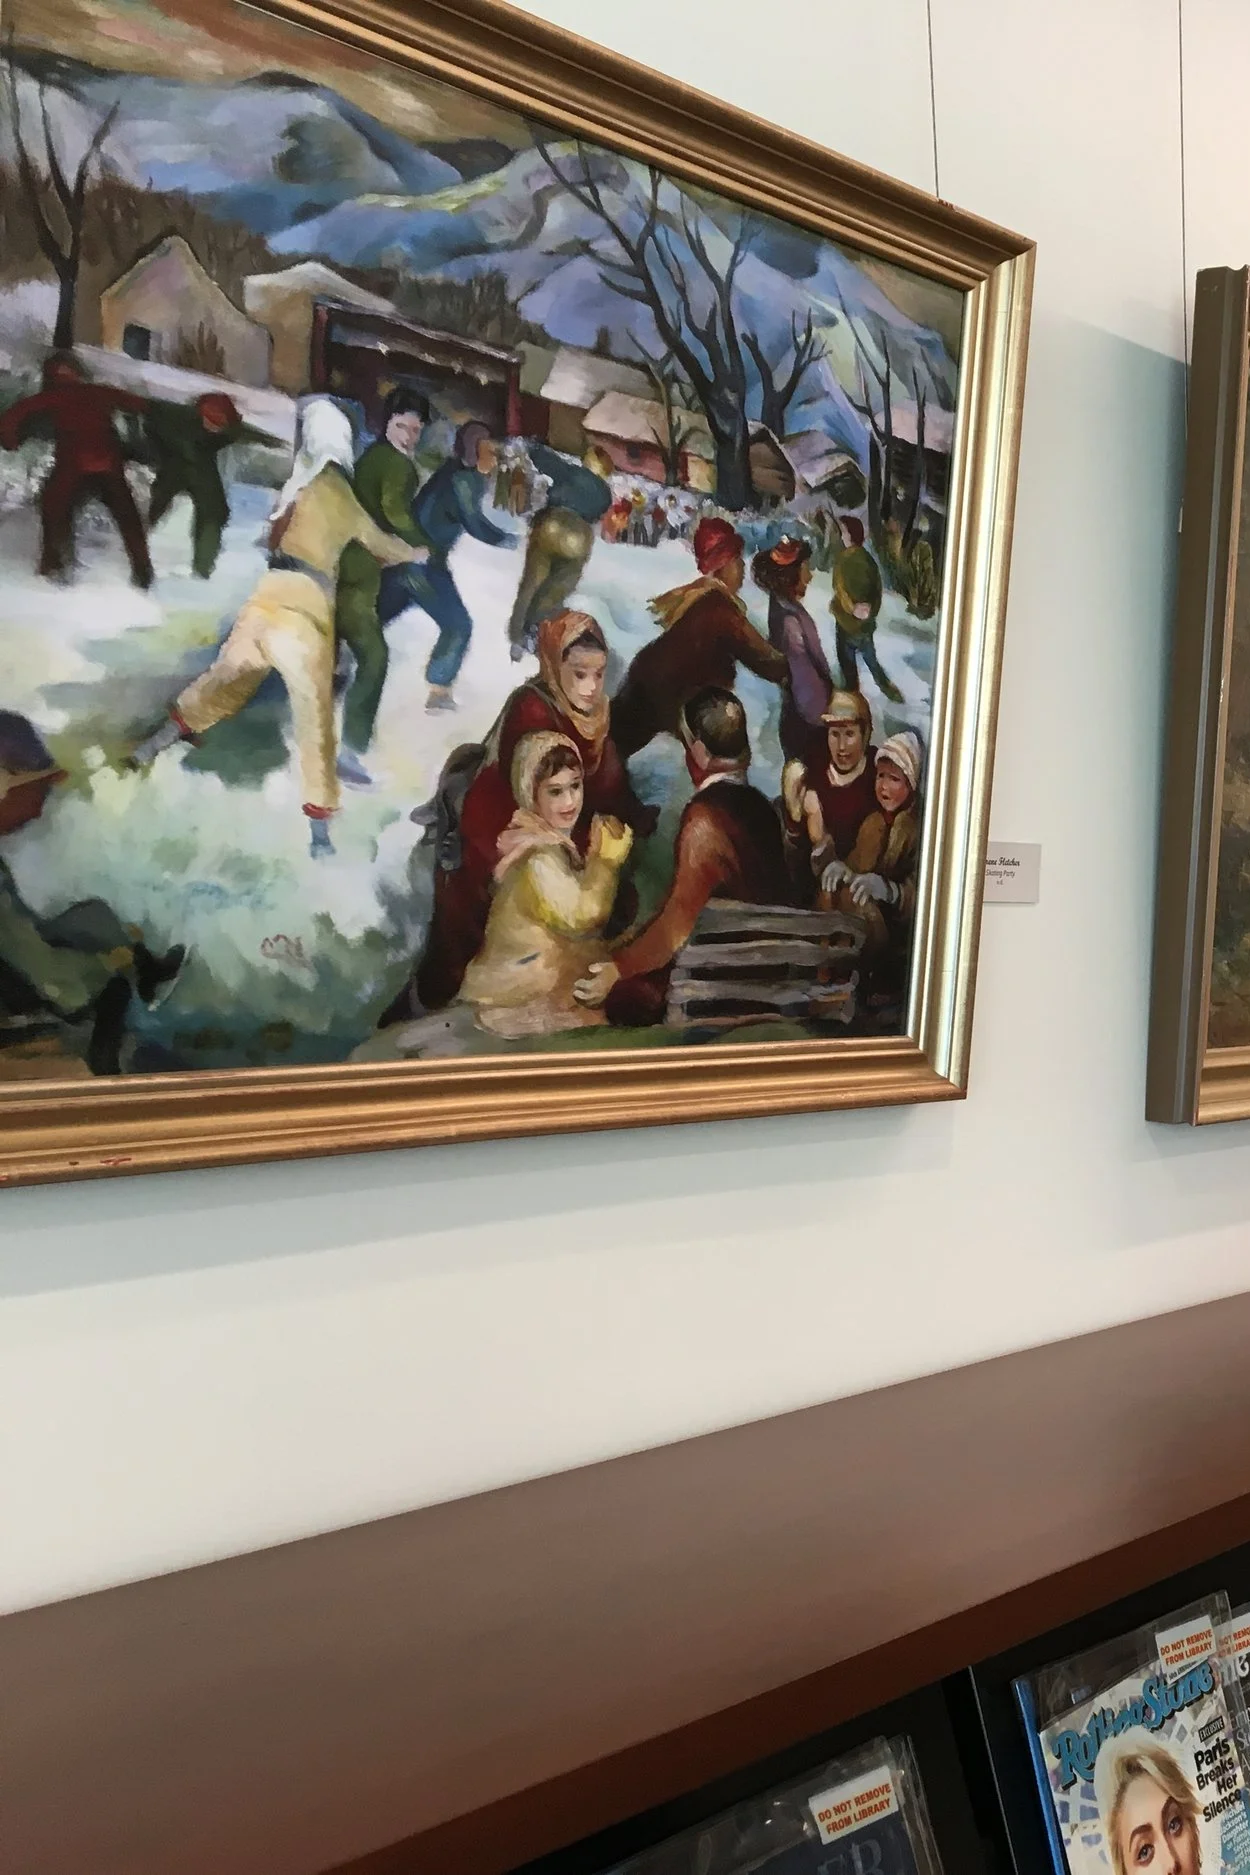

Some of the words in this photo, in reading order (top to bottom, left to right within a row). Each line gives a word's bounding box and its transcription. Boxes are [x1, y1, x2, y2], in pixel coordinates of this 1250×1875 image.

[1160, 1645, 1170, 1656] DO
[1171, 1640, 1186, 1652] NOT
[1186, 1628, 1213, 1647] REMOVE
[1165, 1652, 1185, 1666] FROM
[1185, 1641, 1213, 1659] LIBRARY
[1194, 1736, 1231, 1773] Paris
[1196, 1757, 1235, 1791] Breaks
[1216, 1773, 1238, 1796] Her
[818, 1809, 832, 1823] DO
[832, 1800, 853, 1817] NOT
[853, 1783, 892, 1807] REMOVE
[825, 1816, 853, 1835] FROM
[853, 1798, 892, 1823] LIBRARY
[1202, 1788, 1242, 1823] Silence
